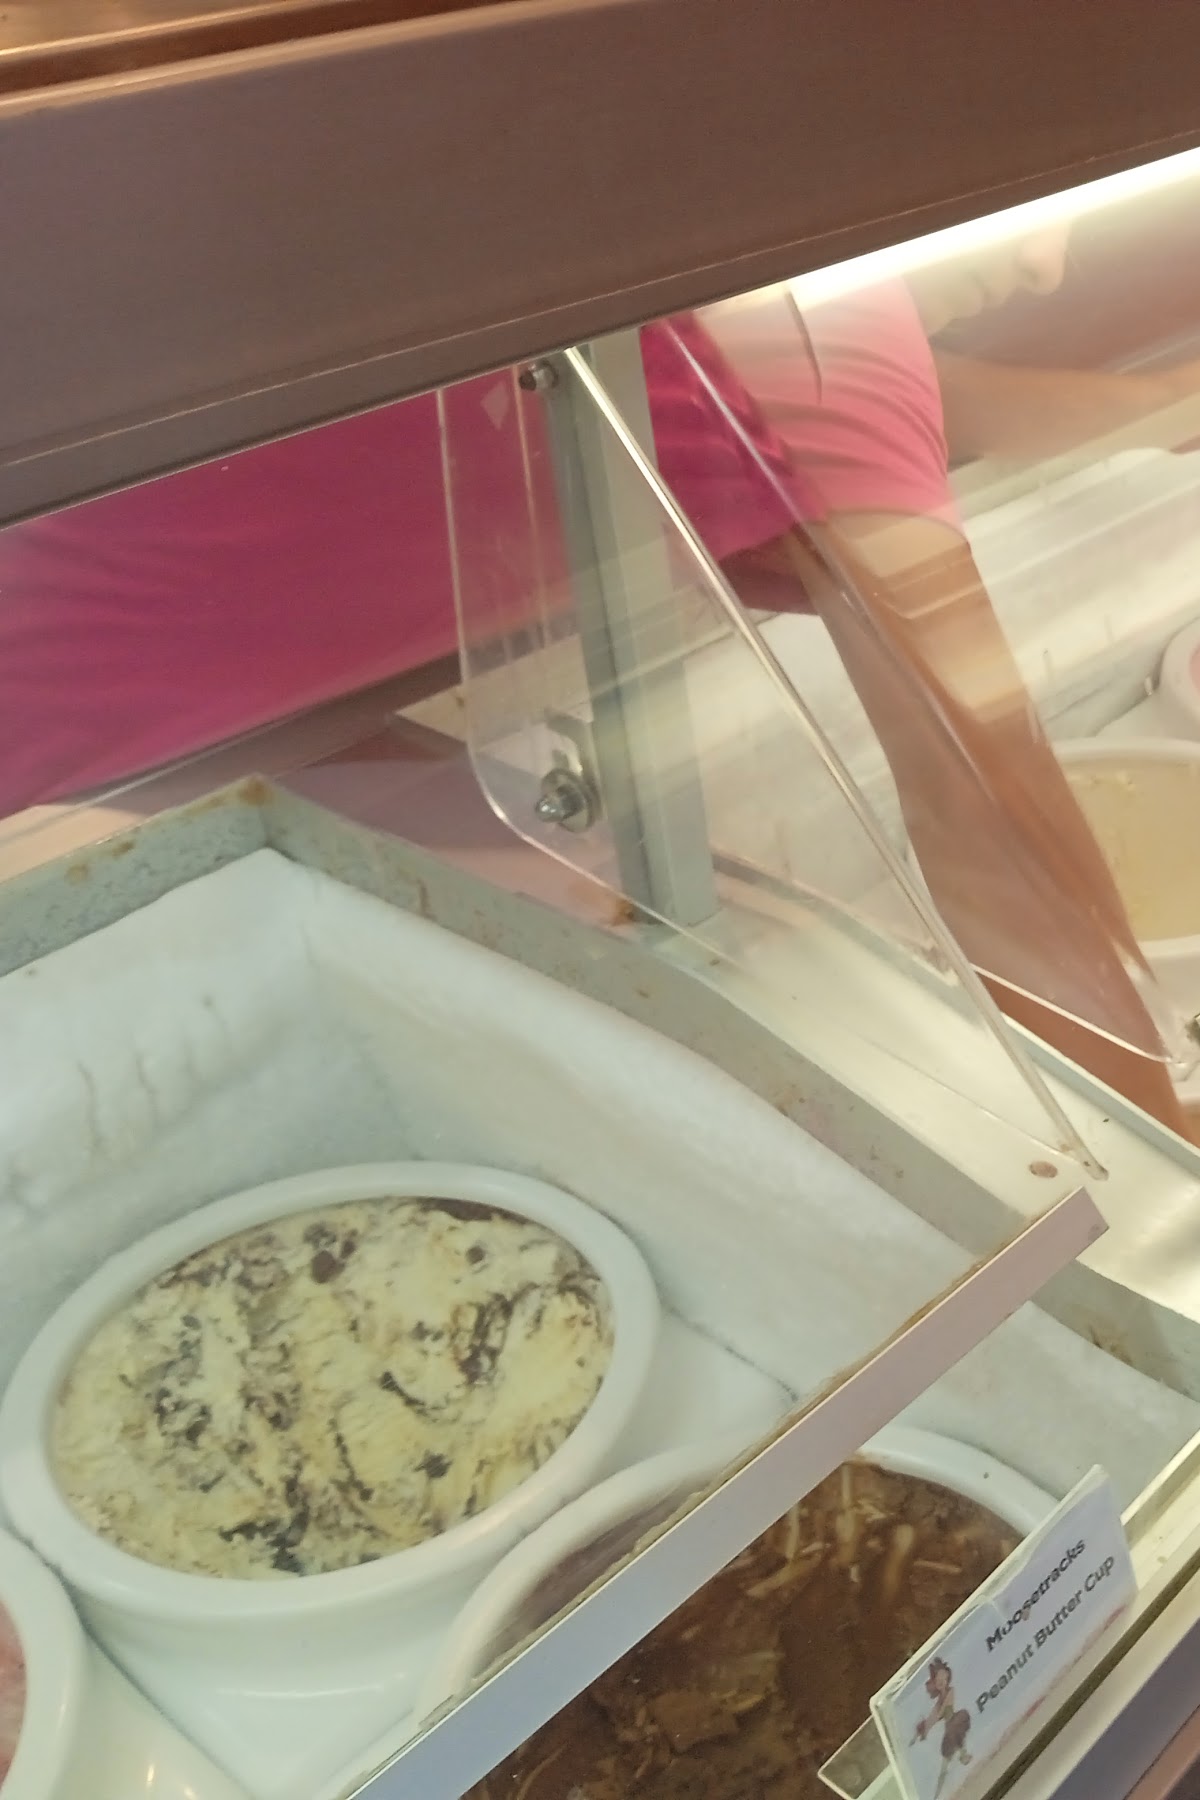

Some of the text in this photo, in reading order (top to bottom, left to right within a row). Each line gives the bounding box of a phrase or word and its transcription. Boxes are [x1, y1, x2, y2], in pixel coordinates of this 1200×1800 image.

[976, 1556, 1115, 1713] Peanut Butter Cup
[985, 1539, 1086, 1652] Moosetracks
